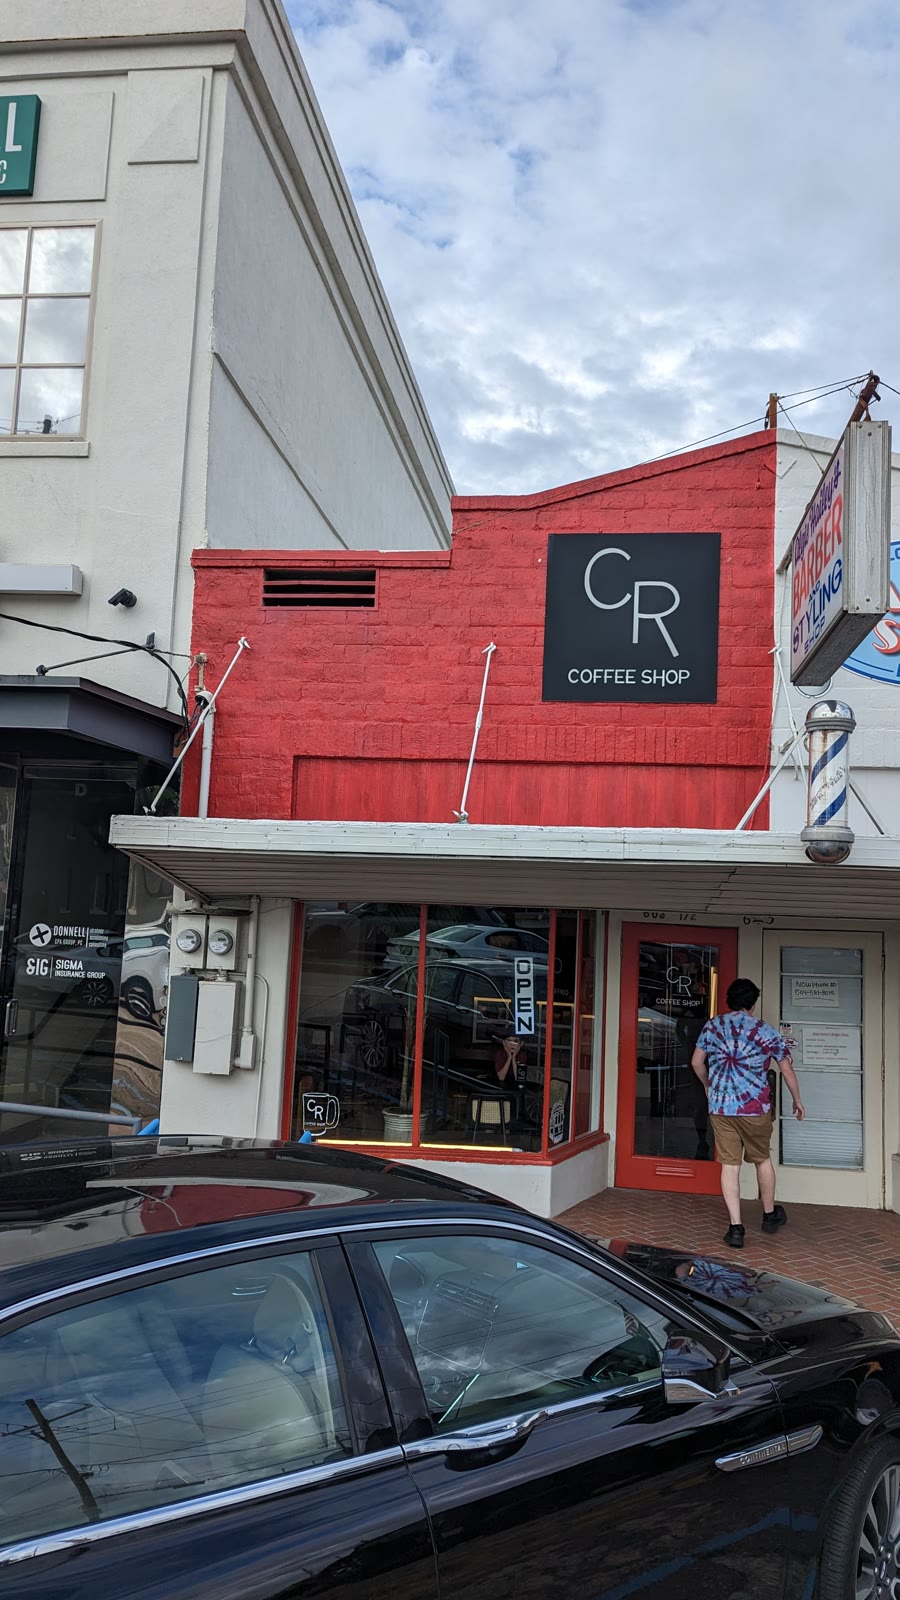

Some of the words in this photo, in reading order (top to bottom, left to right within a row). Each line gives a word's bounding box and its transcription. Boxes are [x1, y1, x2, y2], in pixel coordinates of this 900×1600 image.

[793, 494, 842, 620] BARBER
[808, 580, 821, 603] AND
[792, 558, 842, 654] STYLING
[804, 615, 826, 655] SHOP
[567, 668, 637, 684] COFFEE
[641, 669, 690, 687] SHOP
[53, 926, 86, 938] DONNELL
[54, 970, 86, 978] INSURANCE
[86, 971, 106, 979] GROUP
[55, 960, 84, 971] SIGMA
[516, 959, 533, 1032] OPEN
[655, 998, 681, 1006] COFFEE
[682, 999, 700, 1007] SHOP
